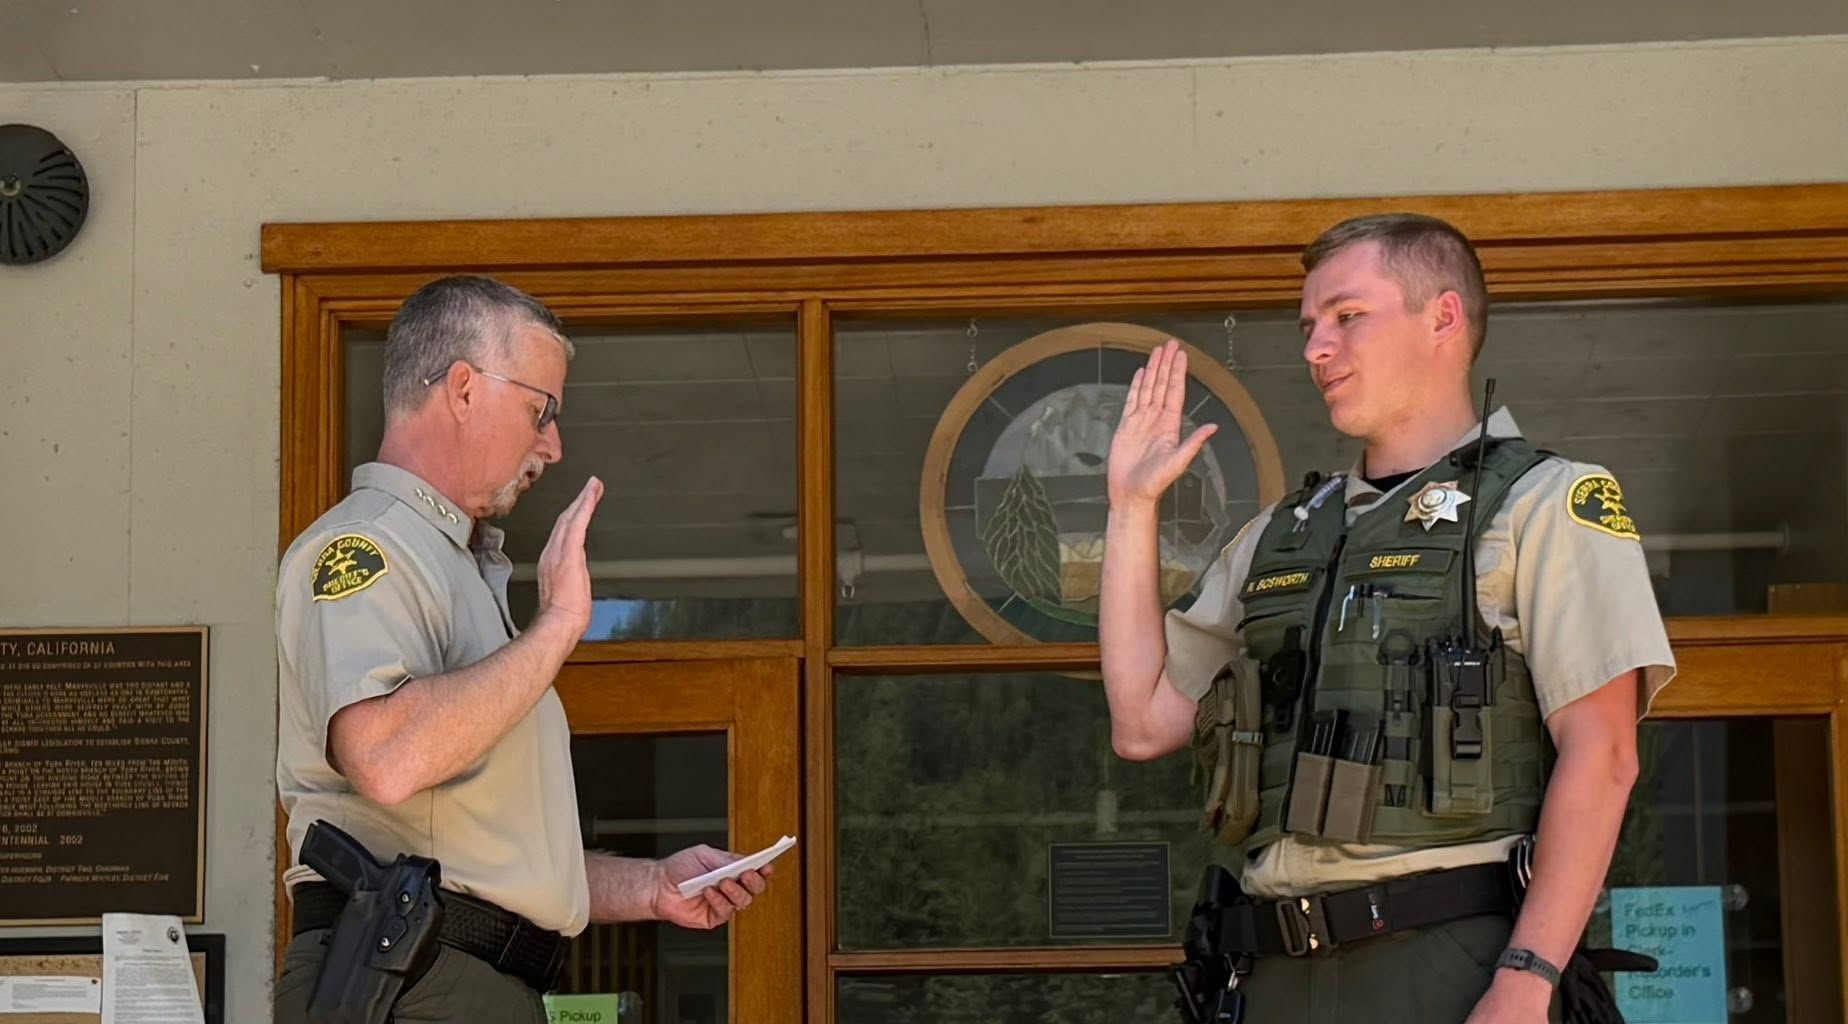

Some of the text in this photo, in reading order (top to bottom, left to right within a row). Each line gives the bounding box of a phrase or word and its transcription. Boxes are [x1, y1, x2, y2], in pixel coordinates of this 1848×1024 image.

[337, 537, 379, 556] COUNTY
[1369, 554, 1421, 569] SHERIFF
[1256, 572, 1310, 592] BOSWORTH
[27, 641, 116, 656] CALIFORNIA
[60, 835, 83, 846] 2002
[1624, 903, 1675, 917] FedEx
[1626, 923, 1696, 939] Pickup in
[1628, 985, 1675, 1000] Office
[560, 1010, 602, 1023] Pickup
